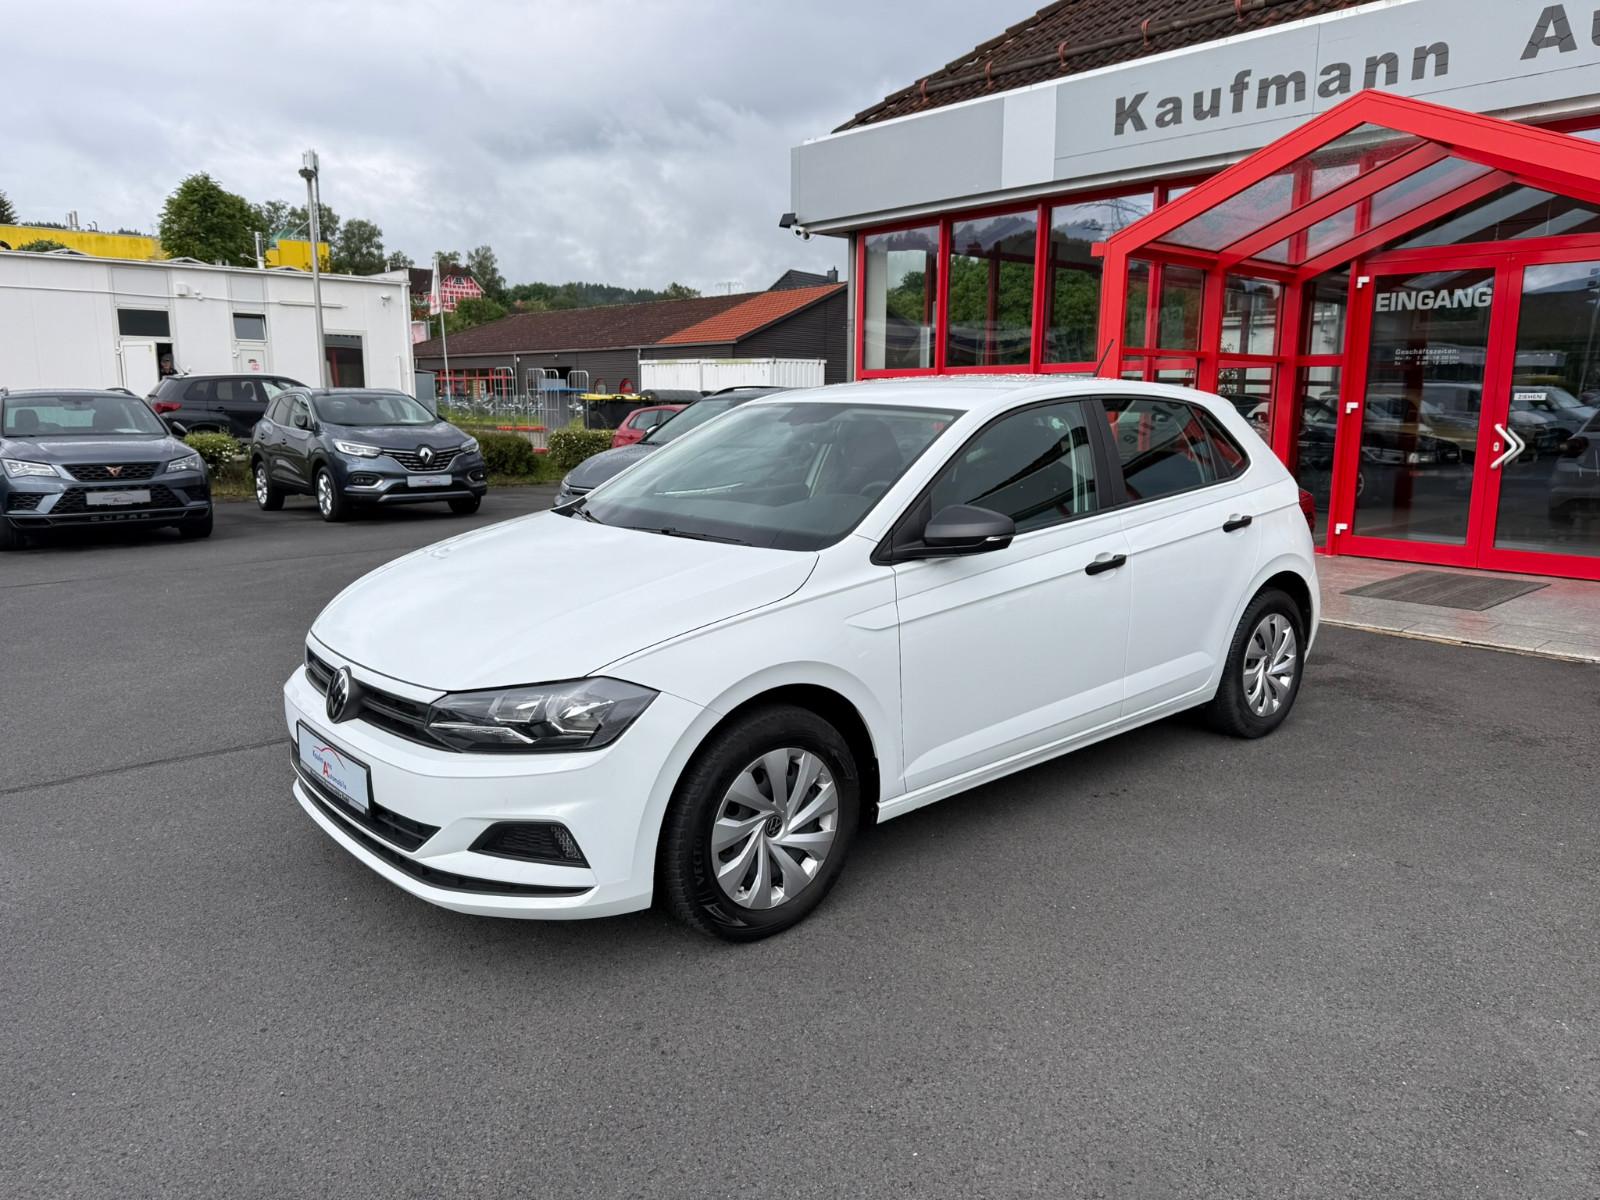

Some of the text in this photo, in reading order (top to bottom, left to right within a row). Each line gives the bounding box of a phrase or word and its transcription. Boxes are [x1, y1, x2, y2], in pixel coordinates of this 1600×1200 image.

[1114, 3, 1600, 136] Kaufmann A
[1375, 287, 1493, 312] EINGANG
